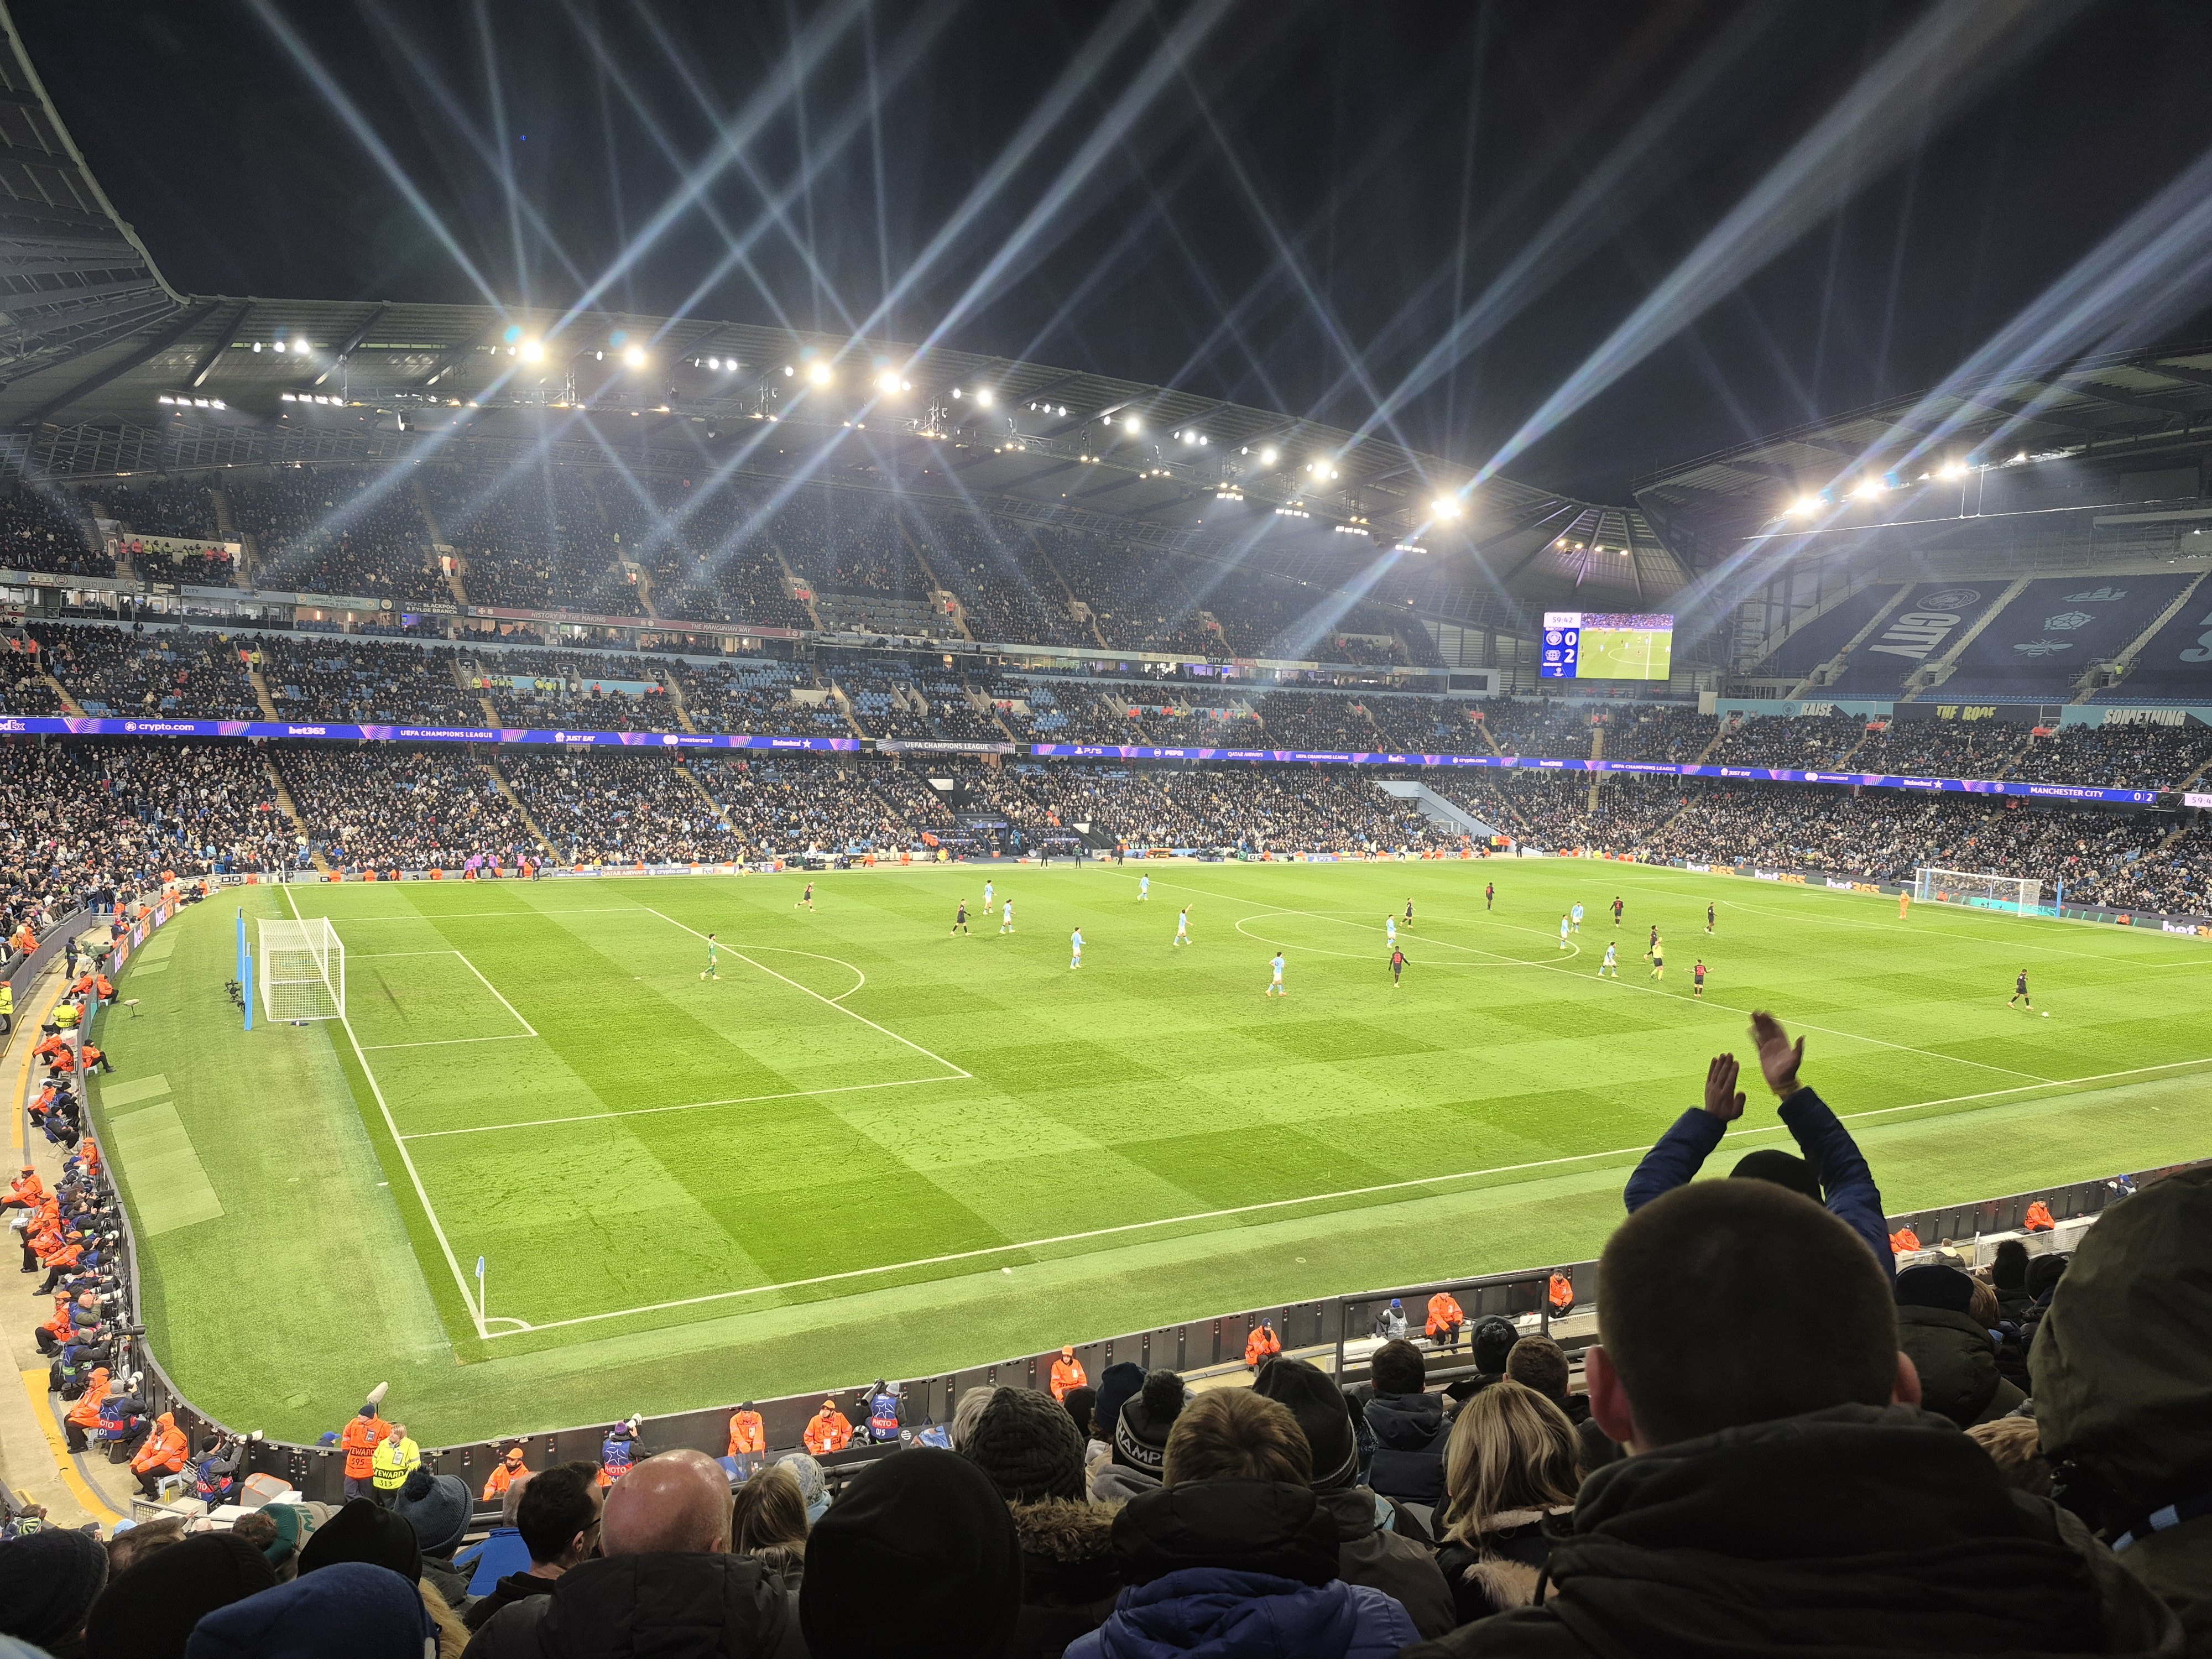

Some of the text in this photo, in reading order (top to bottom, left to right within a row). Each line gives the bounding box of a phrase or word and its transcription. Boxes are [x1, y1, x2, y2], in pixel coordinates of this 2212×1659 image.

[703, 624, 737, 633] MANCUNIAN
[1869, 612, 1961, 659] CITY
[1564, 632, 1577, 646] 0
[1564, 649, 1575, 663] 2
[1800, 703, 1835, 717] RAISE
[1937, 706, 1959, 719] THE
[1962, 706, 1997, 720] ROOF
[2103, 708, 2186, 726] SOMETHING
[0, 719, 25, 731] edEx
[139, 723, 195, 732] crypto.com
[289, 726, 326, 735] bet365
[2031, 787, 2083, 797] MANCHESTER
[2146, 793, 2153, 802] 2
[1687, 862, 1735, 876] bet365
[1755, 869, 1806, 884] bet365
[1827, 878, 1880, 894] bet365
[155, 899, 174, 927] bet365
[134, 916, 150, 948] bet365
[2163, 920, 2212, 938] bet3
[114, 937, 129, 973] bet365
[100, 1420, 114, 1428] OTO
[873, 1417, 891, 1427] PHOTO
[1118, 1429, 1161, 1463] HAMP
[375, 1470, 404, 1479] TEWARD
